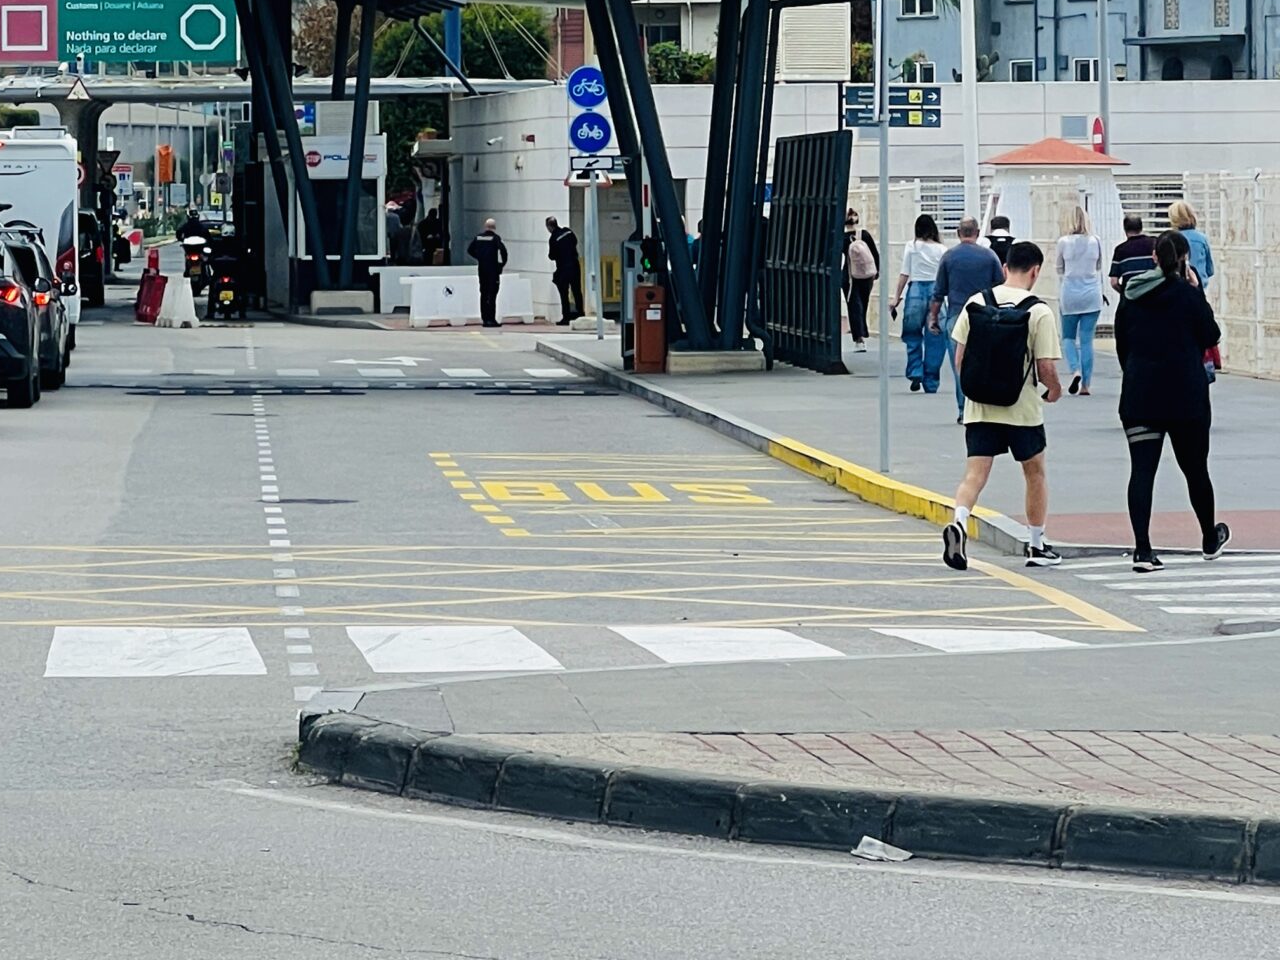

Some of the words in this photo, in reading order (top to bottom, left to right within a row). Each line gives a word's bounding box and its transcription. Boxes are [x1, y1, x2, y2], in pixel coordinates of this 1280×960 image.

[66, 2, 98, 10] Customs
[104, 2, 131, 10] Douane
[66, 31, 110, 43] Nothing
[113, 31, 125, 40] to
[128, 30, 167, 40] declare
[66, 43, 91, 53] Nada
[95, 45, 116, 55] para
[119, 43, 157, 53] declarar
[478, 481, 775, 504] BUS
